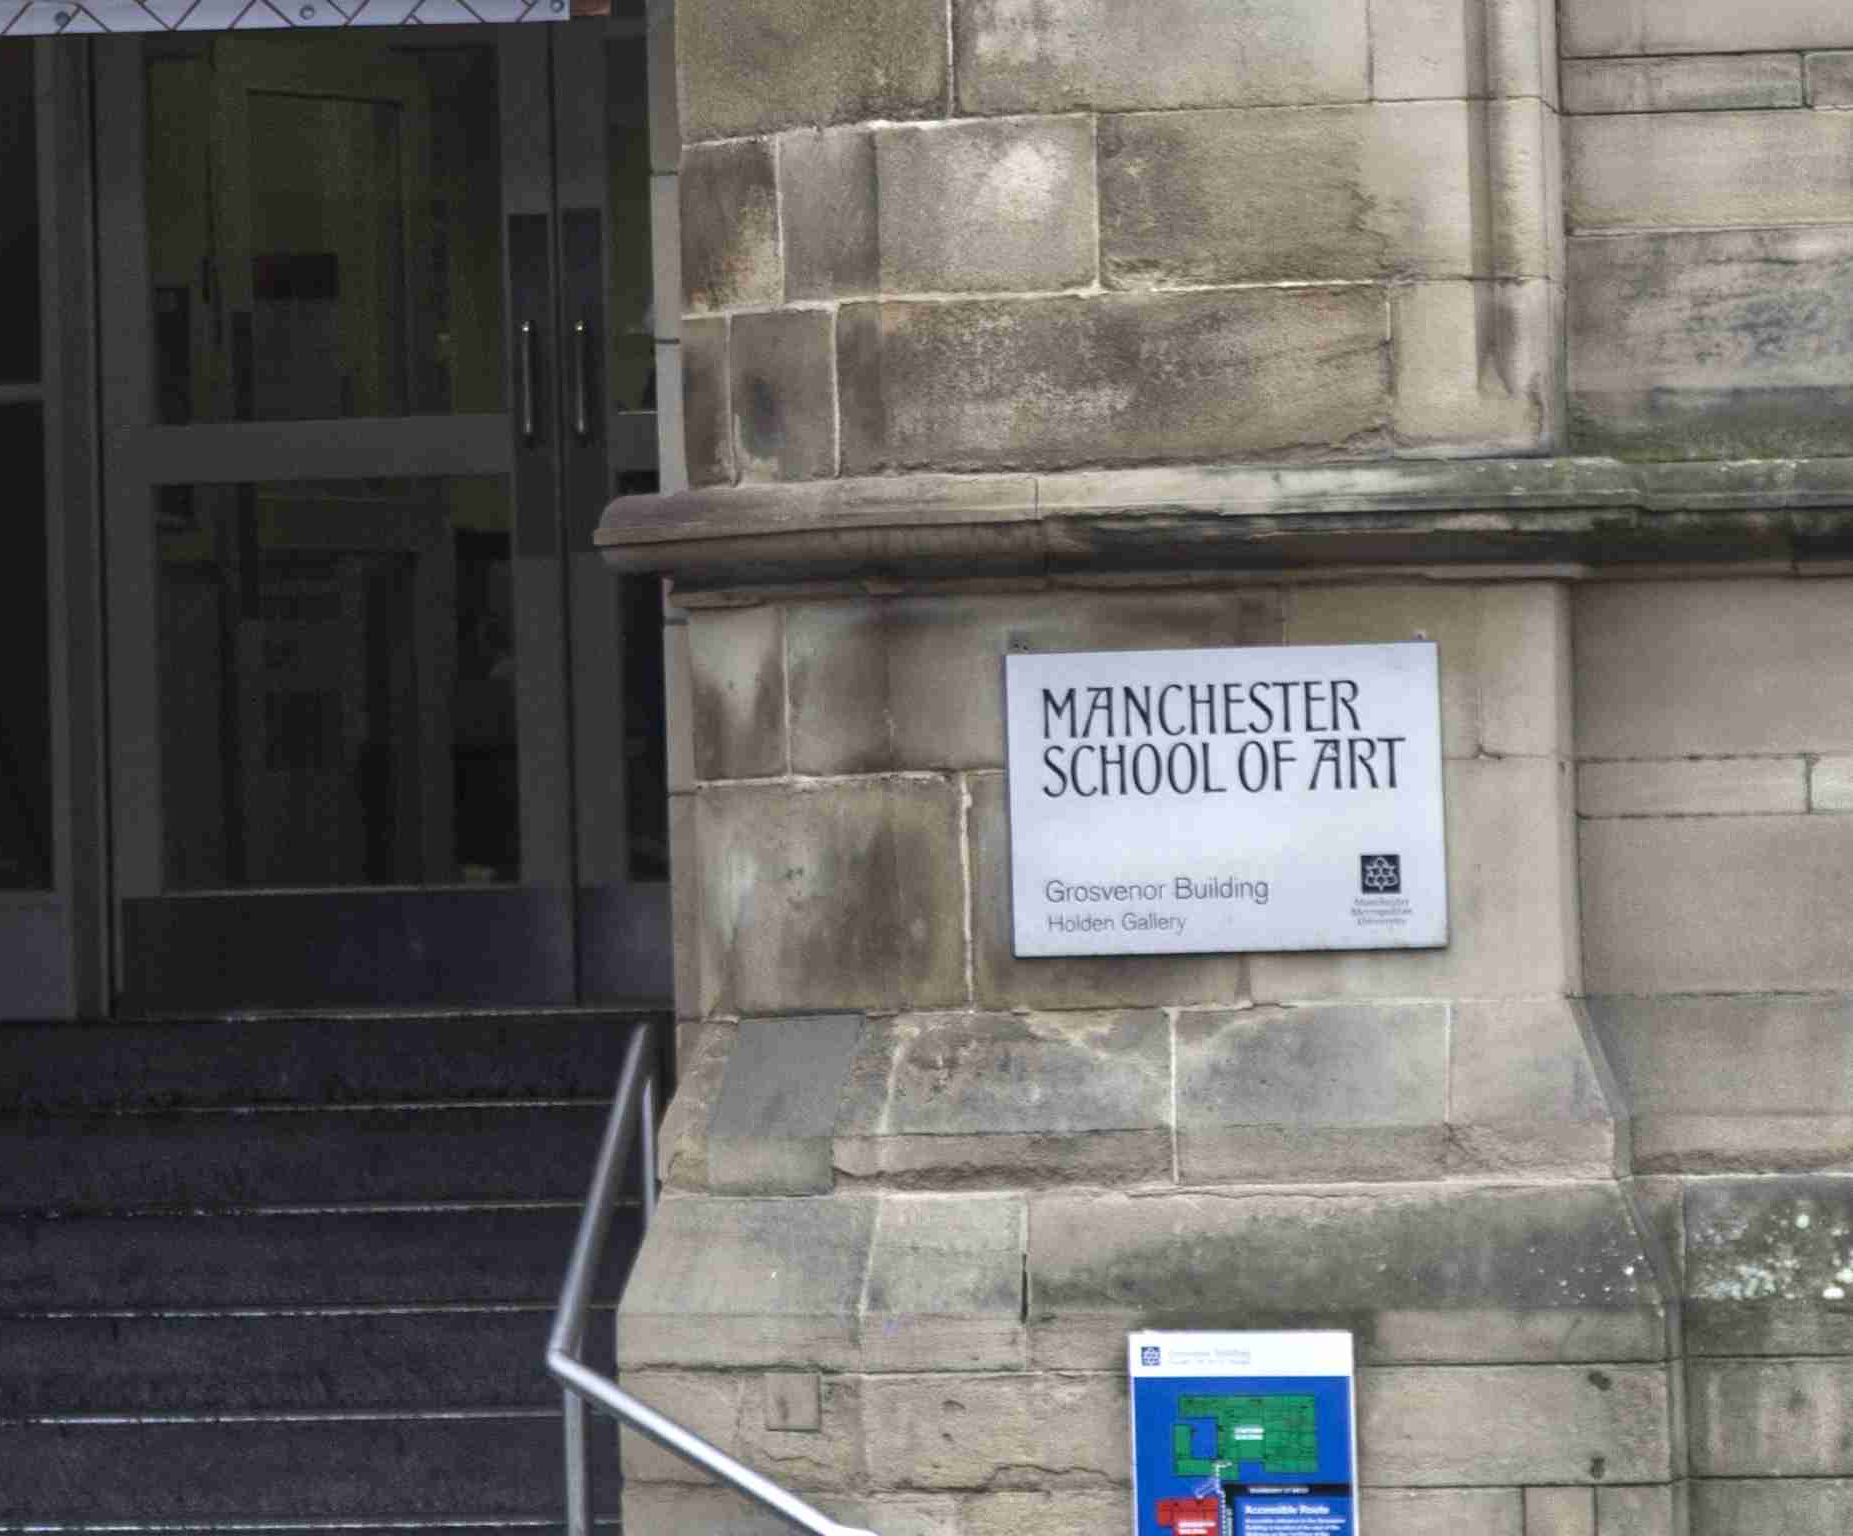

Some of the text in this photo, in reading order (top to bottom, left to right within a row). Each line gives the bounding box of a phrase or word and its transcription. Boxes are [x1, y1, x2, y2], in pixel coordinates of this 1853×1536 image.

[1041, 679, 1362, 740] MANCHESTER
[1042, 737, 1406, 798] SCHOOL OF ART
[1045, 876, 1269, 905] Grosvenor Building
[1047, 912, 1187, 936] Holden Gallery
